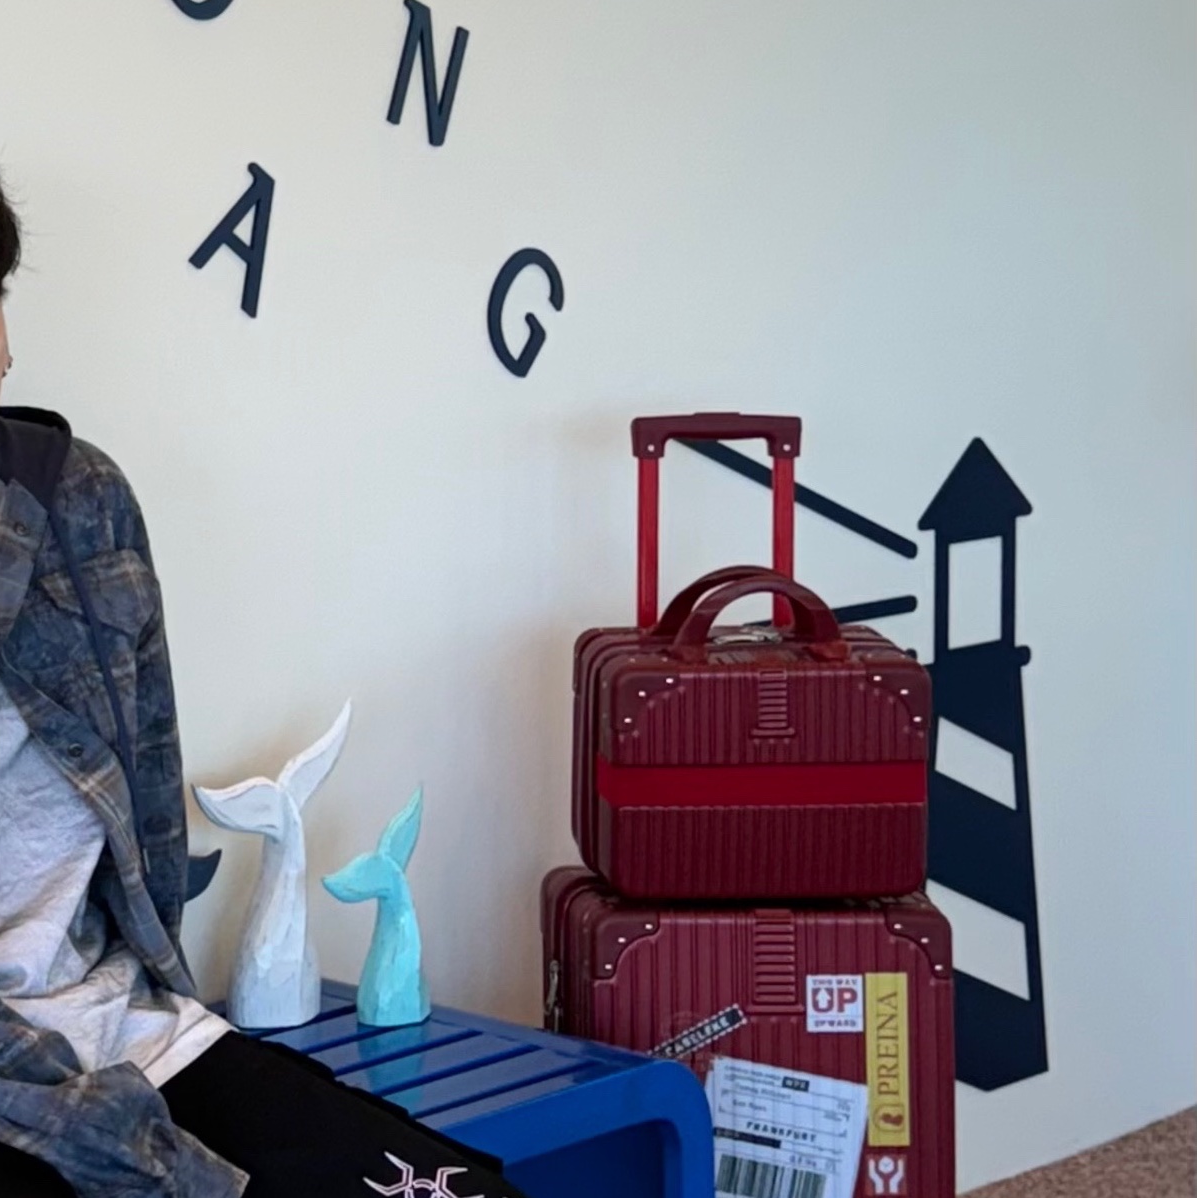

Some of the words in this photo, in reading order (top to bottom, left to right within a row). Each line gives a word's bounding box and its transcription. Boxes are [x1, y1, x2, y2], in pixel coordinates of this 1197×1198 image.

[386, 0, 469, 147] N
[188, 162, 275, 319] A
[486, 247, 564, 378] G
[811, 987, 858, 1013] UP
[876, 991, 900, 1096] PREINA
